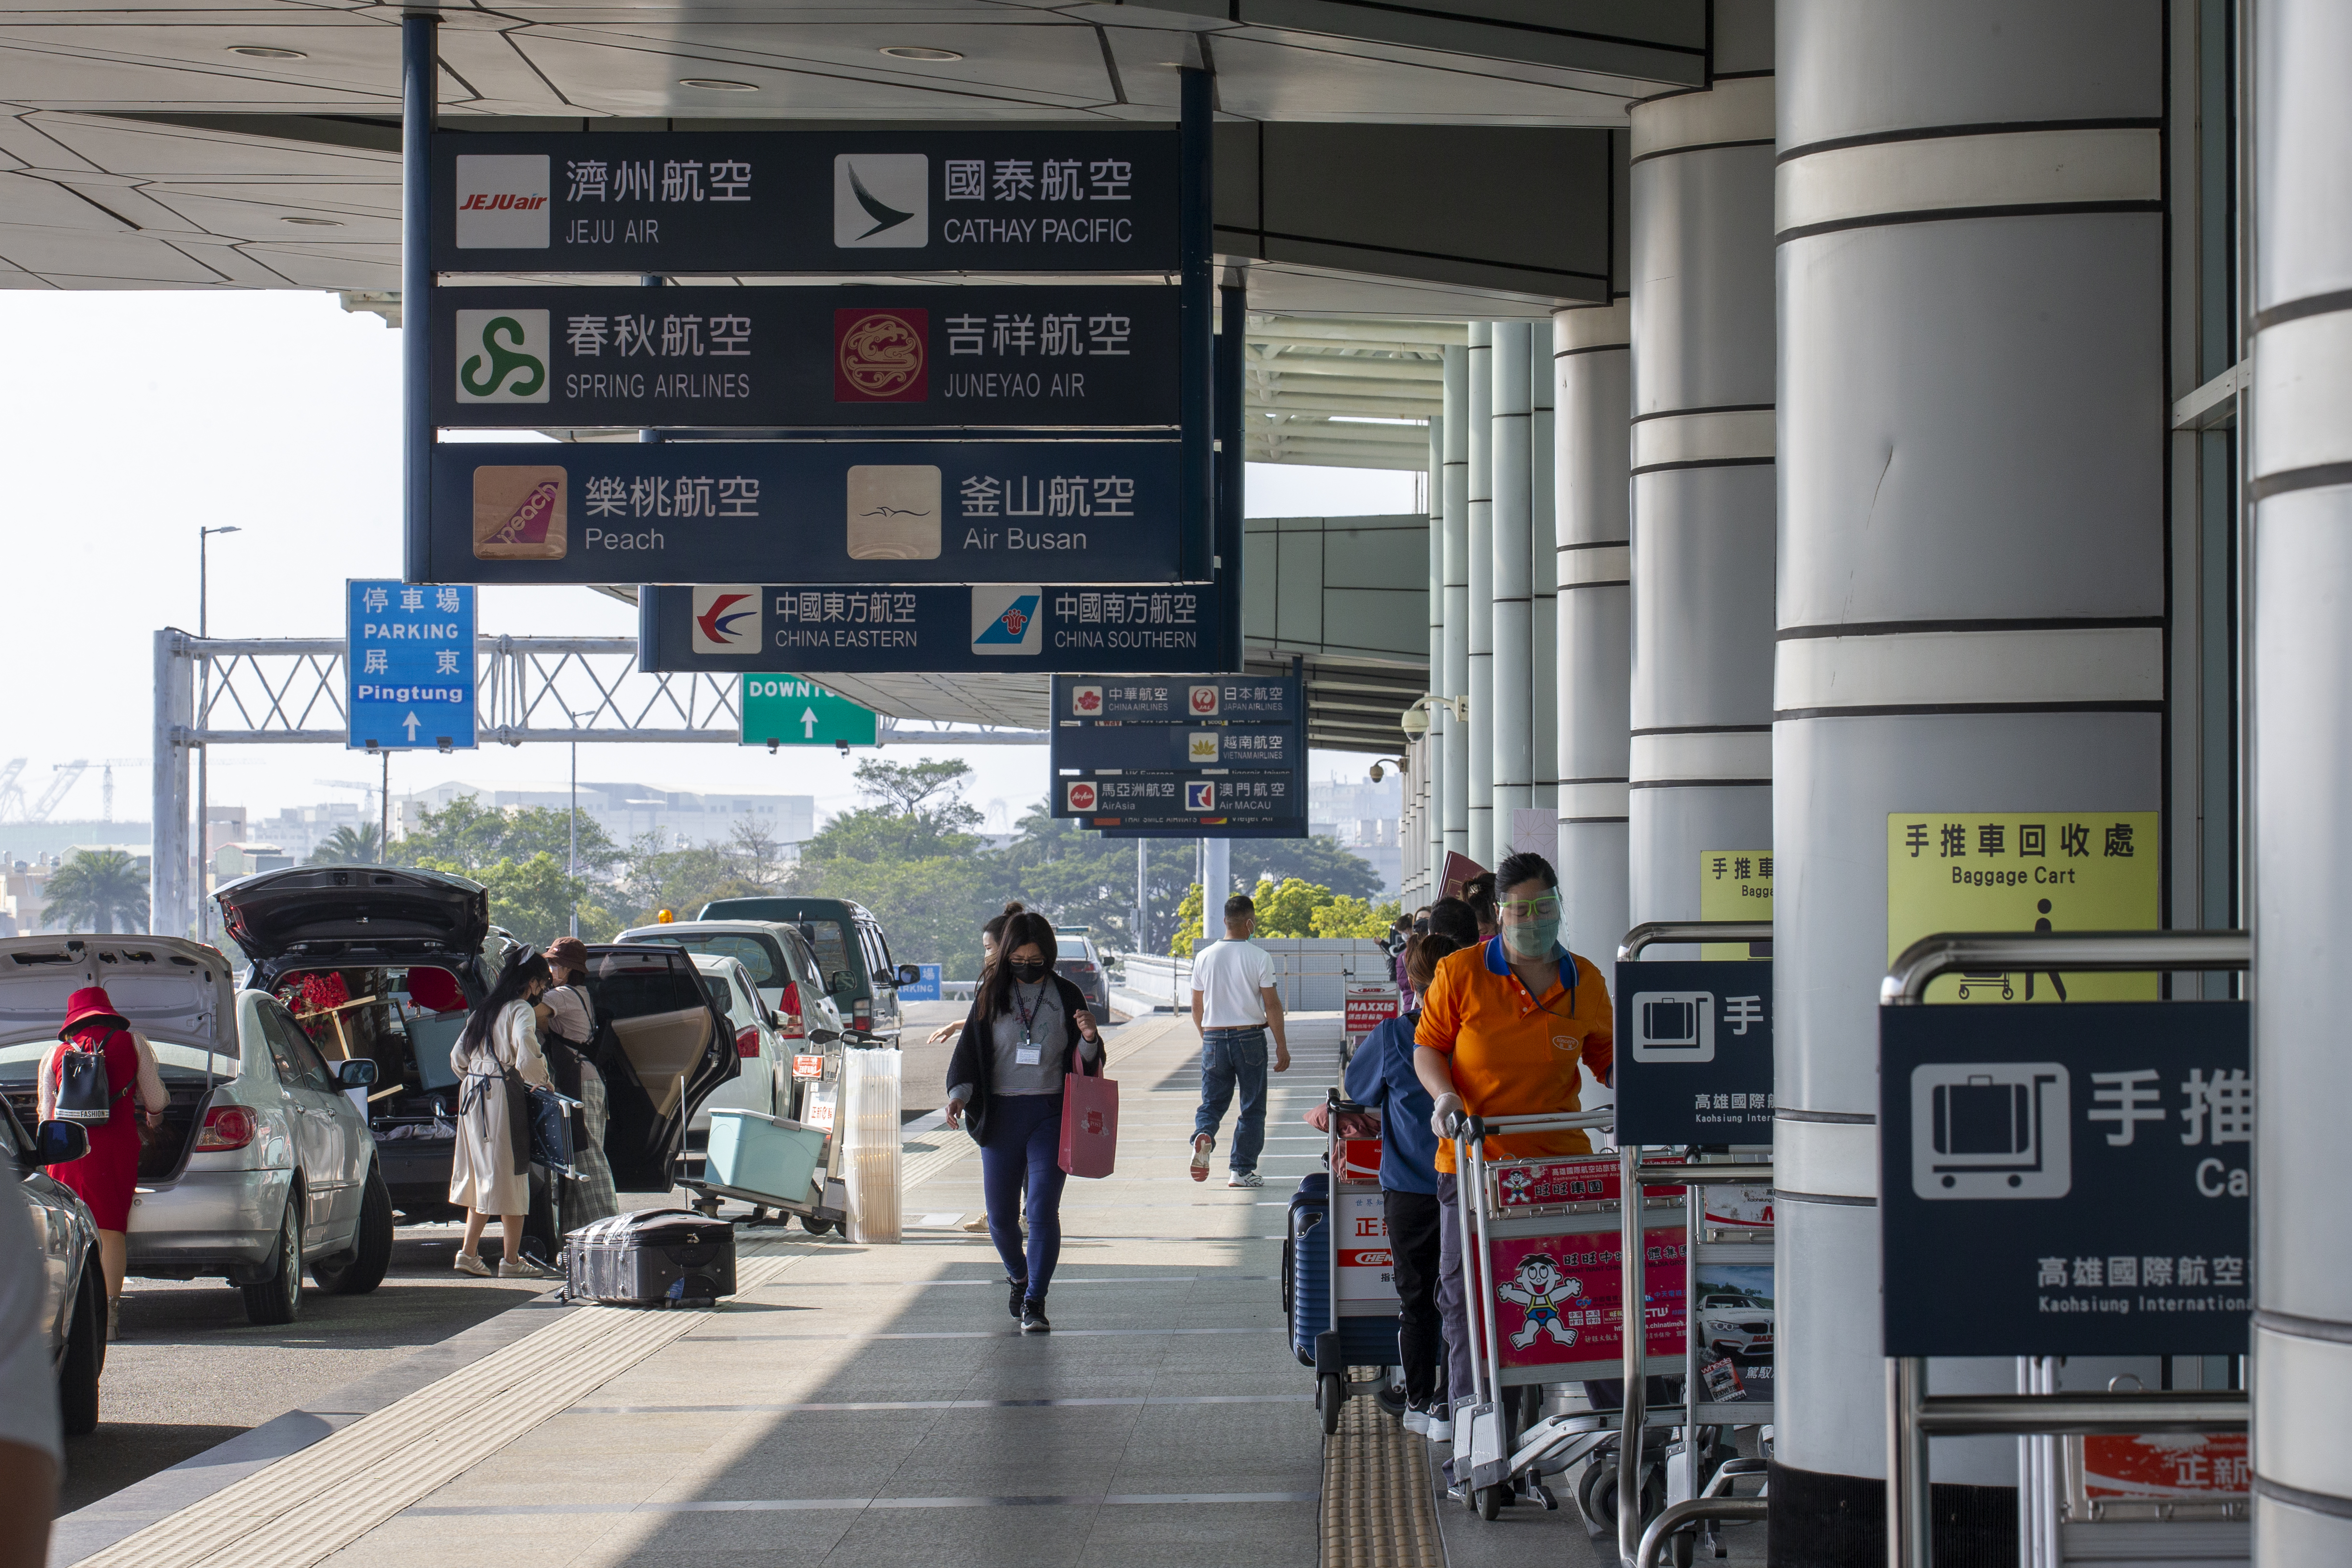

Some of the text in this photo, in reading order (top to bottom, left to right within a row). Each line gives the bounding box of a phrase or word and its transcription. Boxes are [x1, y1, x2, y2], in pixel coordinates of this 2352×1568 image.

[566, 160, 752, 202] 濟州航空
[944, 158, 1132, 201] 國泰航空
[459, 194, 547, 210] JEJUair
[566, 220, 659, 243] JEJU AIR
[943, 218, 1132, 243] CATHAY PACIFIC
[567, 314, 752, 356] 春秋航空
[945, 313, 1131, 356] 吉祥航空
[566, 373, 750, 399] SPRING AIRLINES
[944, 372, 1085, 398] JUNEYAO AIR
[585, 475, 760, 518] 樂桃航空
[960, 475, 1135, 518] 釜山航空
[496, 484, 557, 544] peach
[585, 528, 665, 550] Peach
[963, 527, 1086, 550] Air Busan
[363, 587, 460, 613] 停車場
[776, 592, 916, 623] 中國東方航空
[1055, 592, 1197, 624] 中國南方航空
[364, 623, 458, 639] PARKING
[775, 630, 917, 647] CHINA EASTERN
[1055, 630, 1197, 648] CHINA SOUTHERN
[364, 649, 460, 675] 屏東
[358, 684, 462, 703] Pingtung
[1109, 687, 1168, 700] 中華航空
[1225, 686, 1283, 700] 日本航空
[1109, 703, 1169, 711] CHINA AIRLINES
[1224, 703, 1283, 711] JAPAN AIRLINES
[1223, 735, 1283, 749] 越南航空
[1223, 751, 1283, 759] VIETNAM AIRLINES
[1101, 783, 1175, 797] 馬亞洲航空
[1219, 782, 1285, 797] 澳門航空
[1101, 801, 1135, 810] AirAsia
[1219, 801, 1271, 810] Air MACAU
[1905, 823, 2135, 857] 手推車回收處
[1712, 857, 1773, 880] 手推車
[1952, 866, 2076, 886] Baggage Cart
[897, 984, 934, 993] ARKING
[1347, 1002, 1395, 1012] MAXXIS
[1724, 995, 1773, 1035] 手
[1696, 1113, 1742, 1123] Kaohsiung
[1534, 1179, 1604, 1197] 旺旺集團
[1644, 1244, 1687, 1261] 體集團
[2037, 1256, 2250, 1288] 高雄國際航空
[2038, 1295, 2130, 1314] Kaohsiung
[1701, 1357, 1732, 1374] wheels
[1745, 1366, 1774, 1379] 駕馭
[2175, 1454, 2249, 1485] 正新
